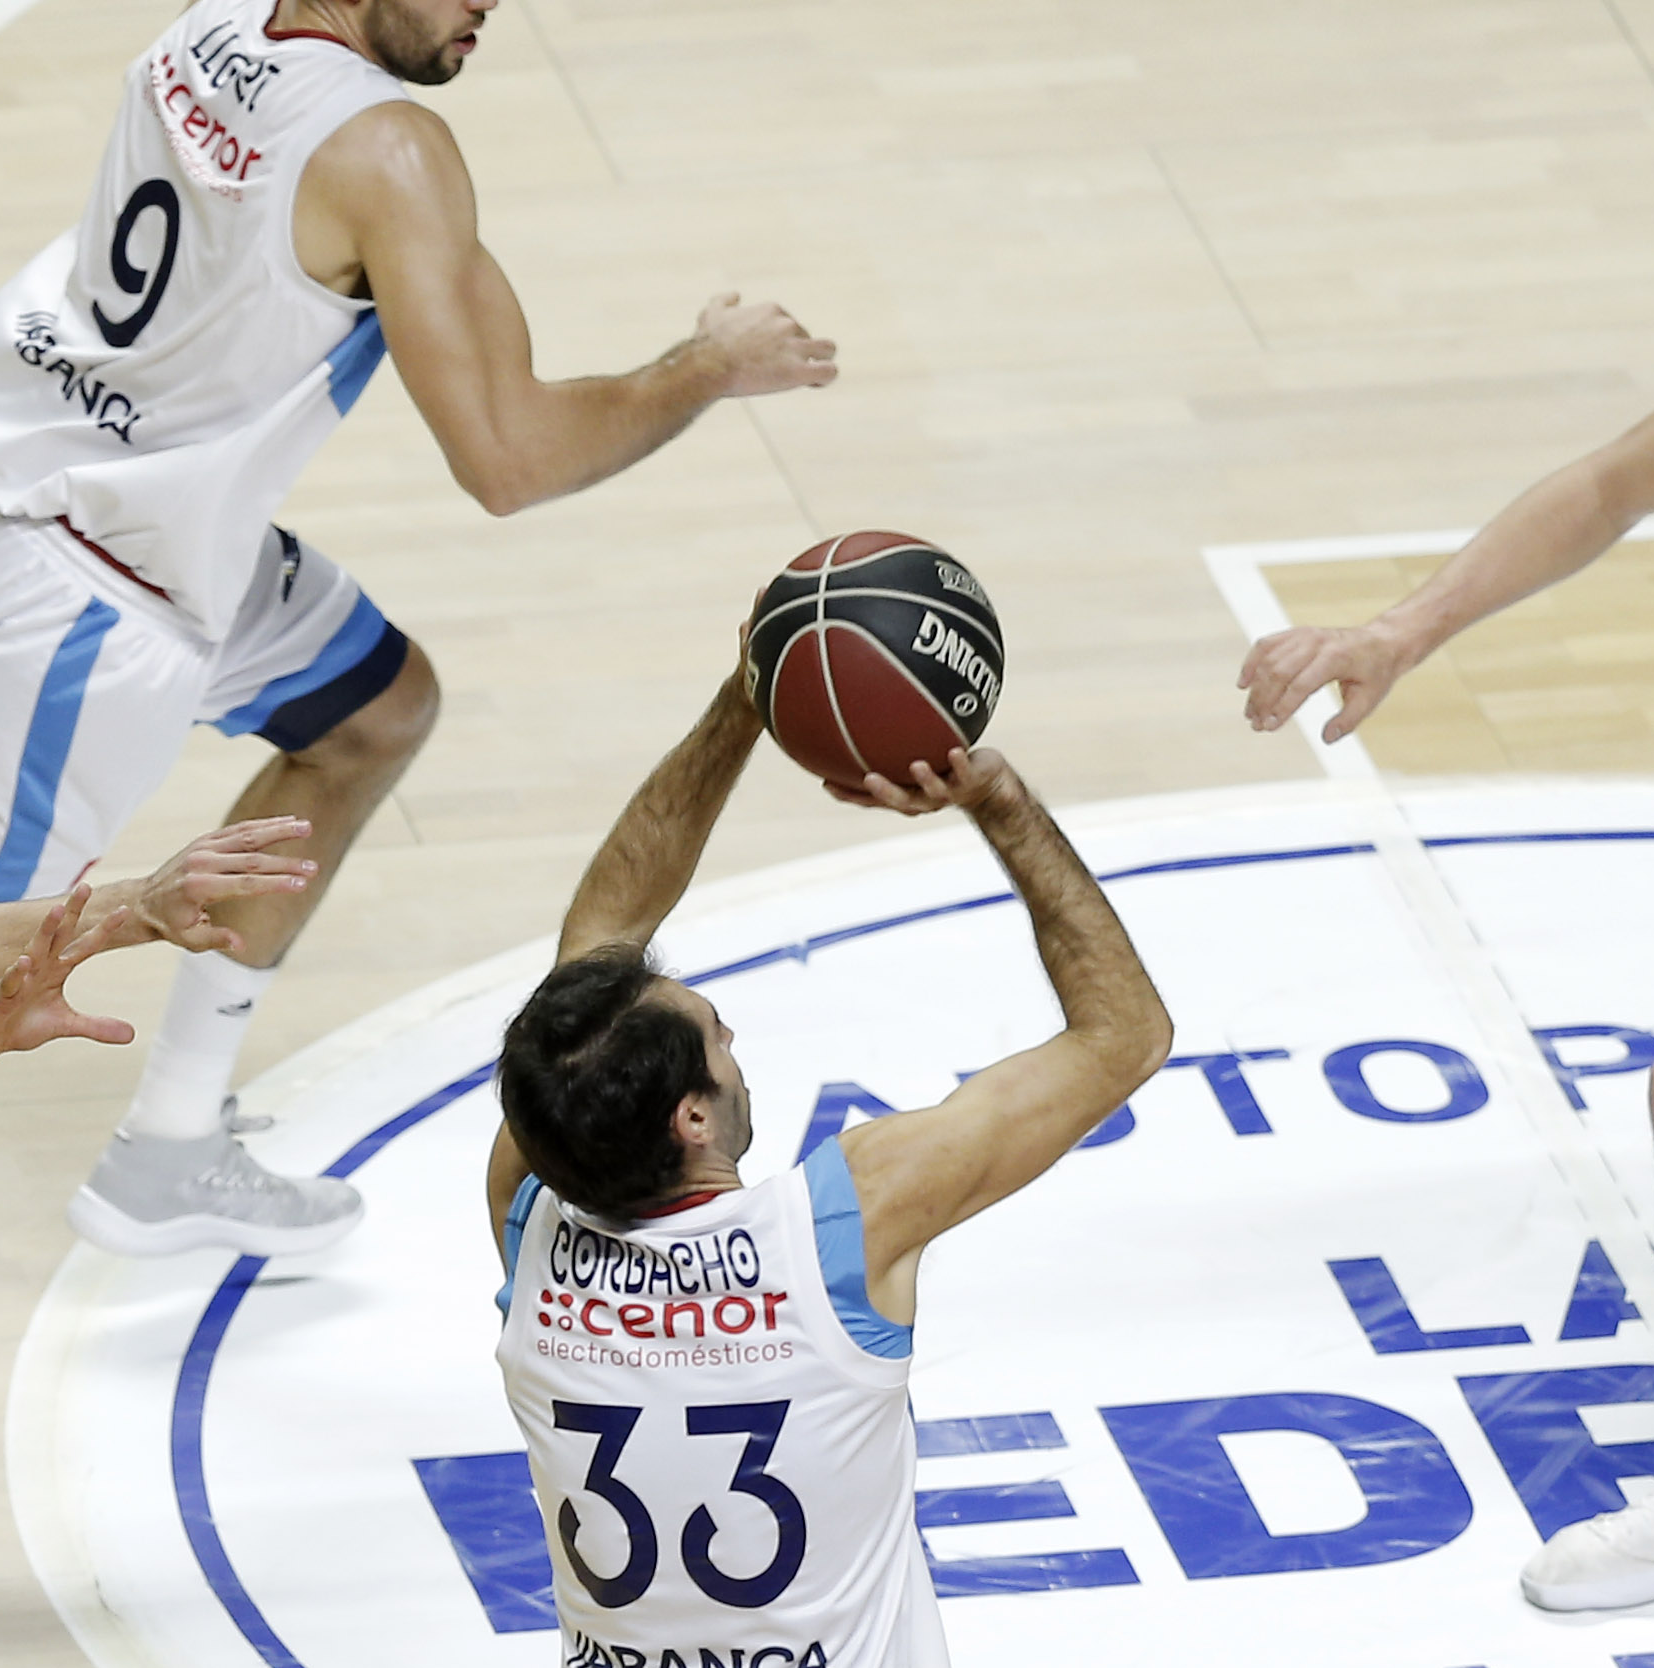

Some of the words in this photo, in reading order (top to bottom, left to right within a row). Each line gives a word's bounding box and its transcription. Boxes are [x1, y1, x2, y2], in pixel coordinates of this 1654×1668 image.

[92, 178, 180, 348] 9
[550, 1222, 761, 1295] CORBACHO
[579, 1291, 788, 1338] cenor
[537, 1338, 794, 1368] electrodomésticos
[552, 1399, 807, 1609] 33
